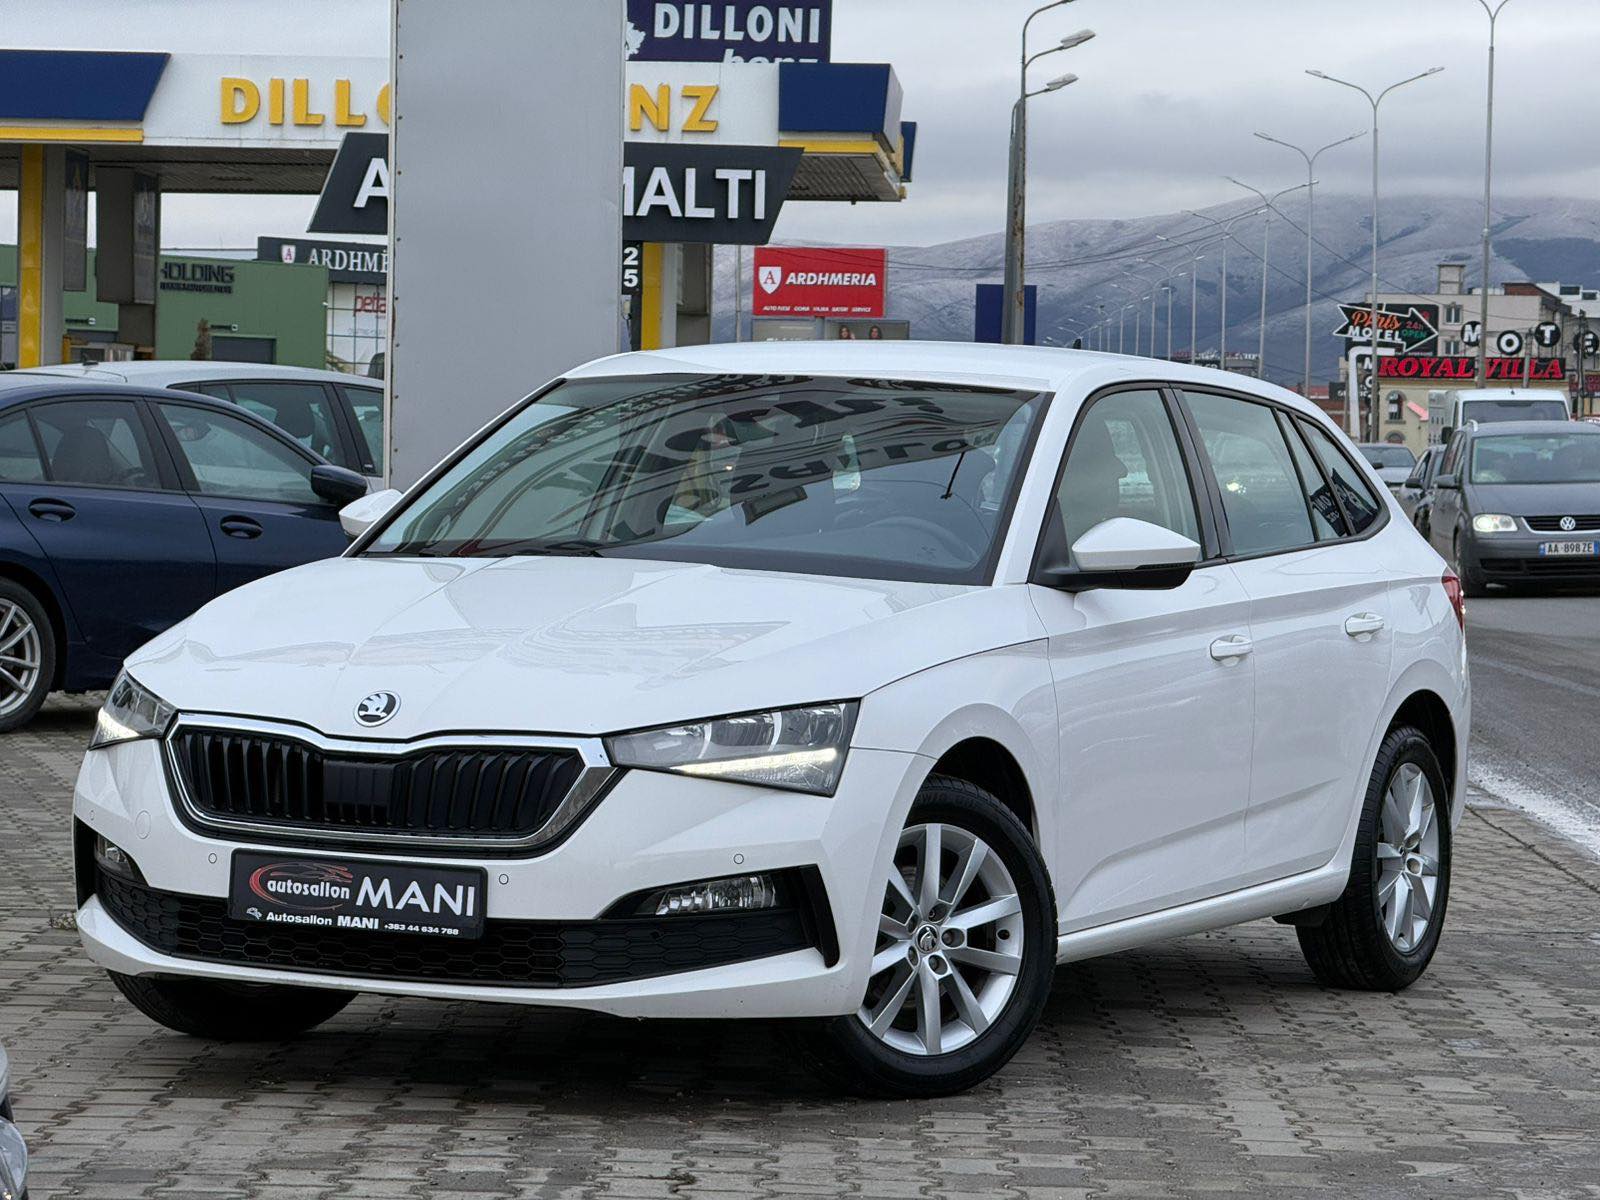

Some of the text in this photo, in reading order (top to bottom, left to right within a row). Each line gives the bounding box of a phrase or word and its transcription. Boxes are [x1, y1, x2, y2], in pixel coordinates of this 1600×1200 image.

[654, 3, 820, 43] DILLONI
[220, 77, 720, 133] DILL NZ
[623, 166, 766, 220] ALTI
[785, 272, 877, 286] ARDHMERIA
[1348, 325, 1402, 341] MOTEL
[1378, 357, 1564, 379] ROYAL VILLA
[267, 876, 475, 917] autosallon MANI
[266, 911, 333, 926] Autosallon
[337, 915, 379, 930] MANI
